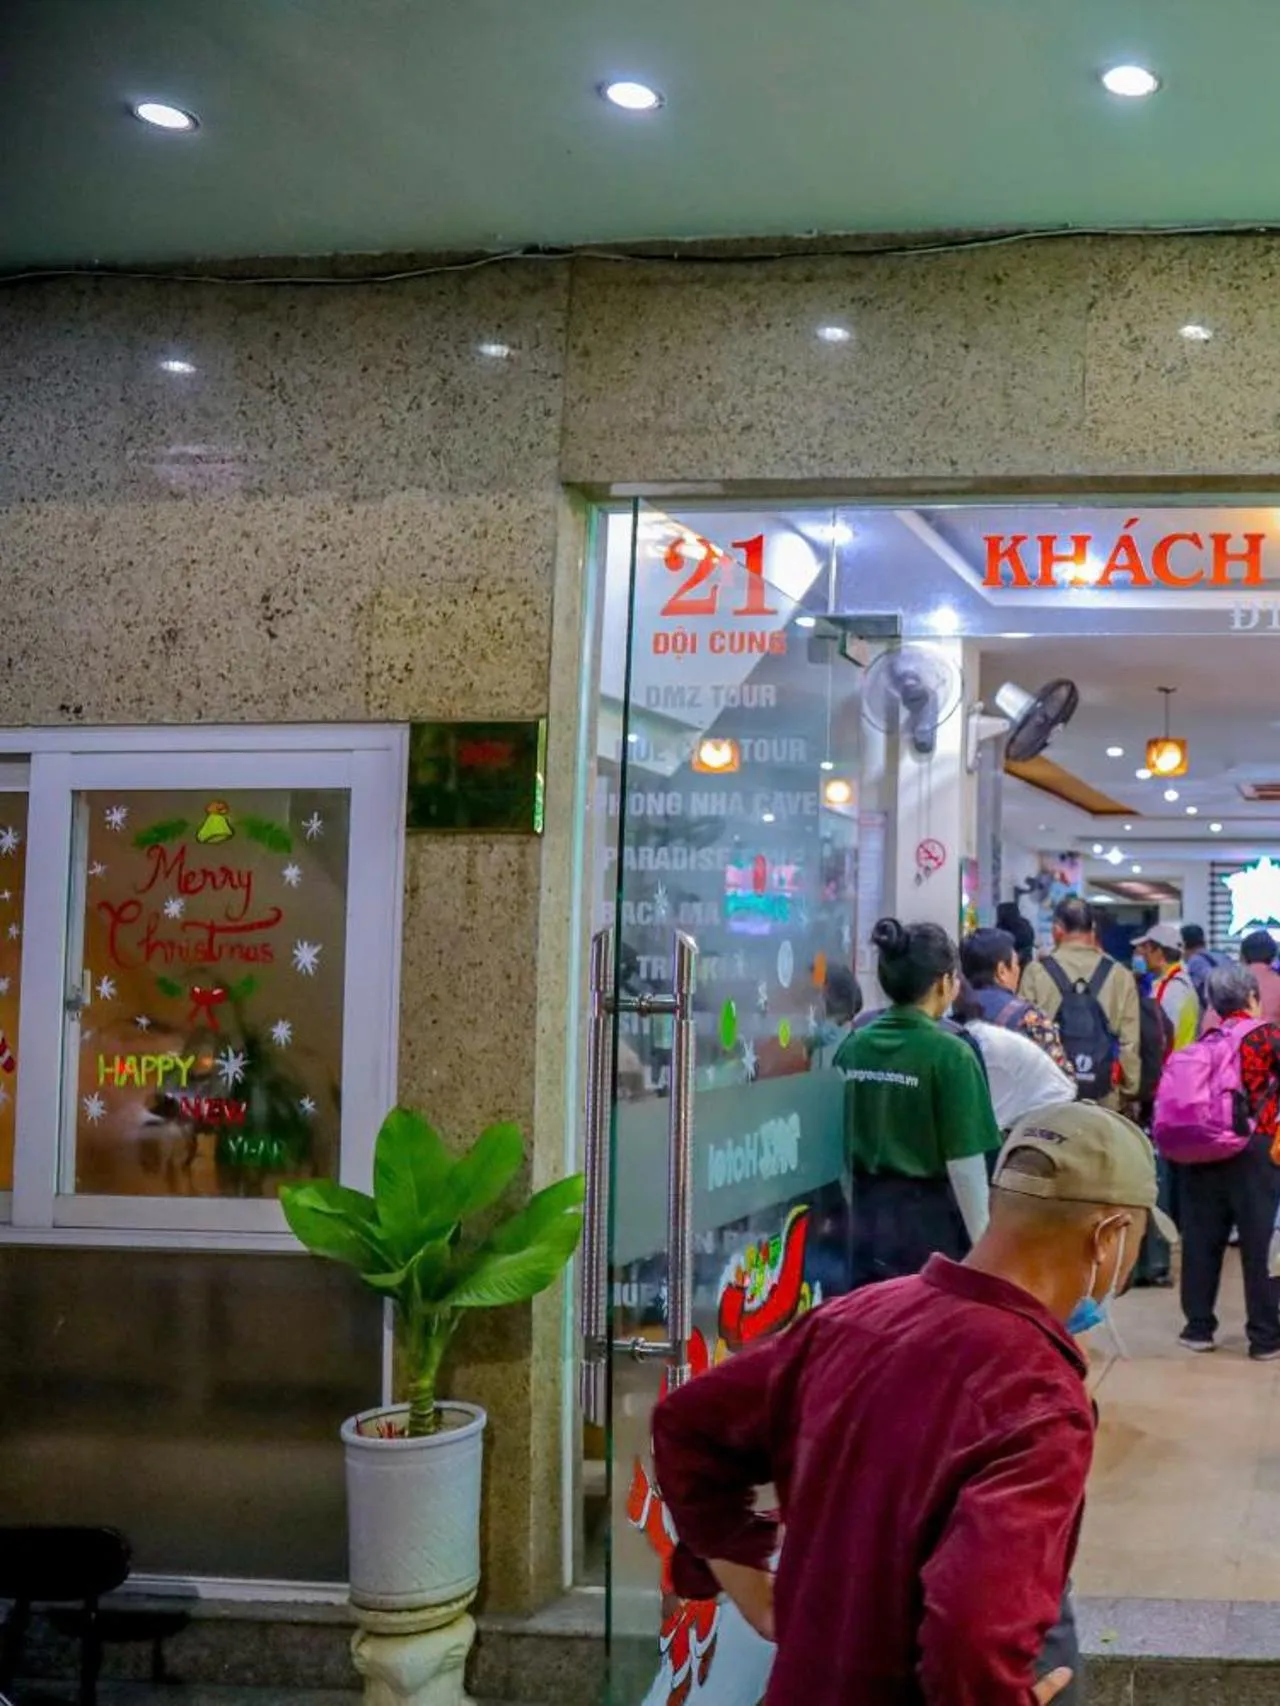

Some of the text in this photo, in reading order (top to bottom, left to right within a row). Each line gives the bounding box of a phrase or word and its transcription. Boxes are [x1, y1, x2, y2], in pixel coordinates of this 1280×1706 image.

[981, 518, 1266, 588] KHÁCH
[660, 533, 779, 618] 21
[708, 630, 787, 655] CUNG
[645, 684, 776, 708] DMZ TOUR
[742, 739, 807, 762] TOUR
[691, 790, 745, 816] NHA
[136, 844, 253, 919] Merry
[102, 900, 283, 969] Christmas
[97, 1054, 195, 1088] HAPPY
[179, 1097, 247, 1127] NEW
